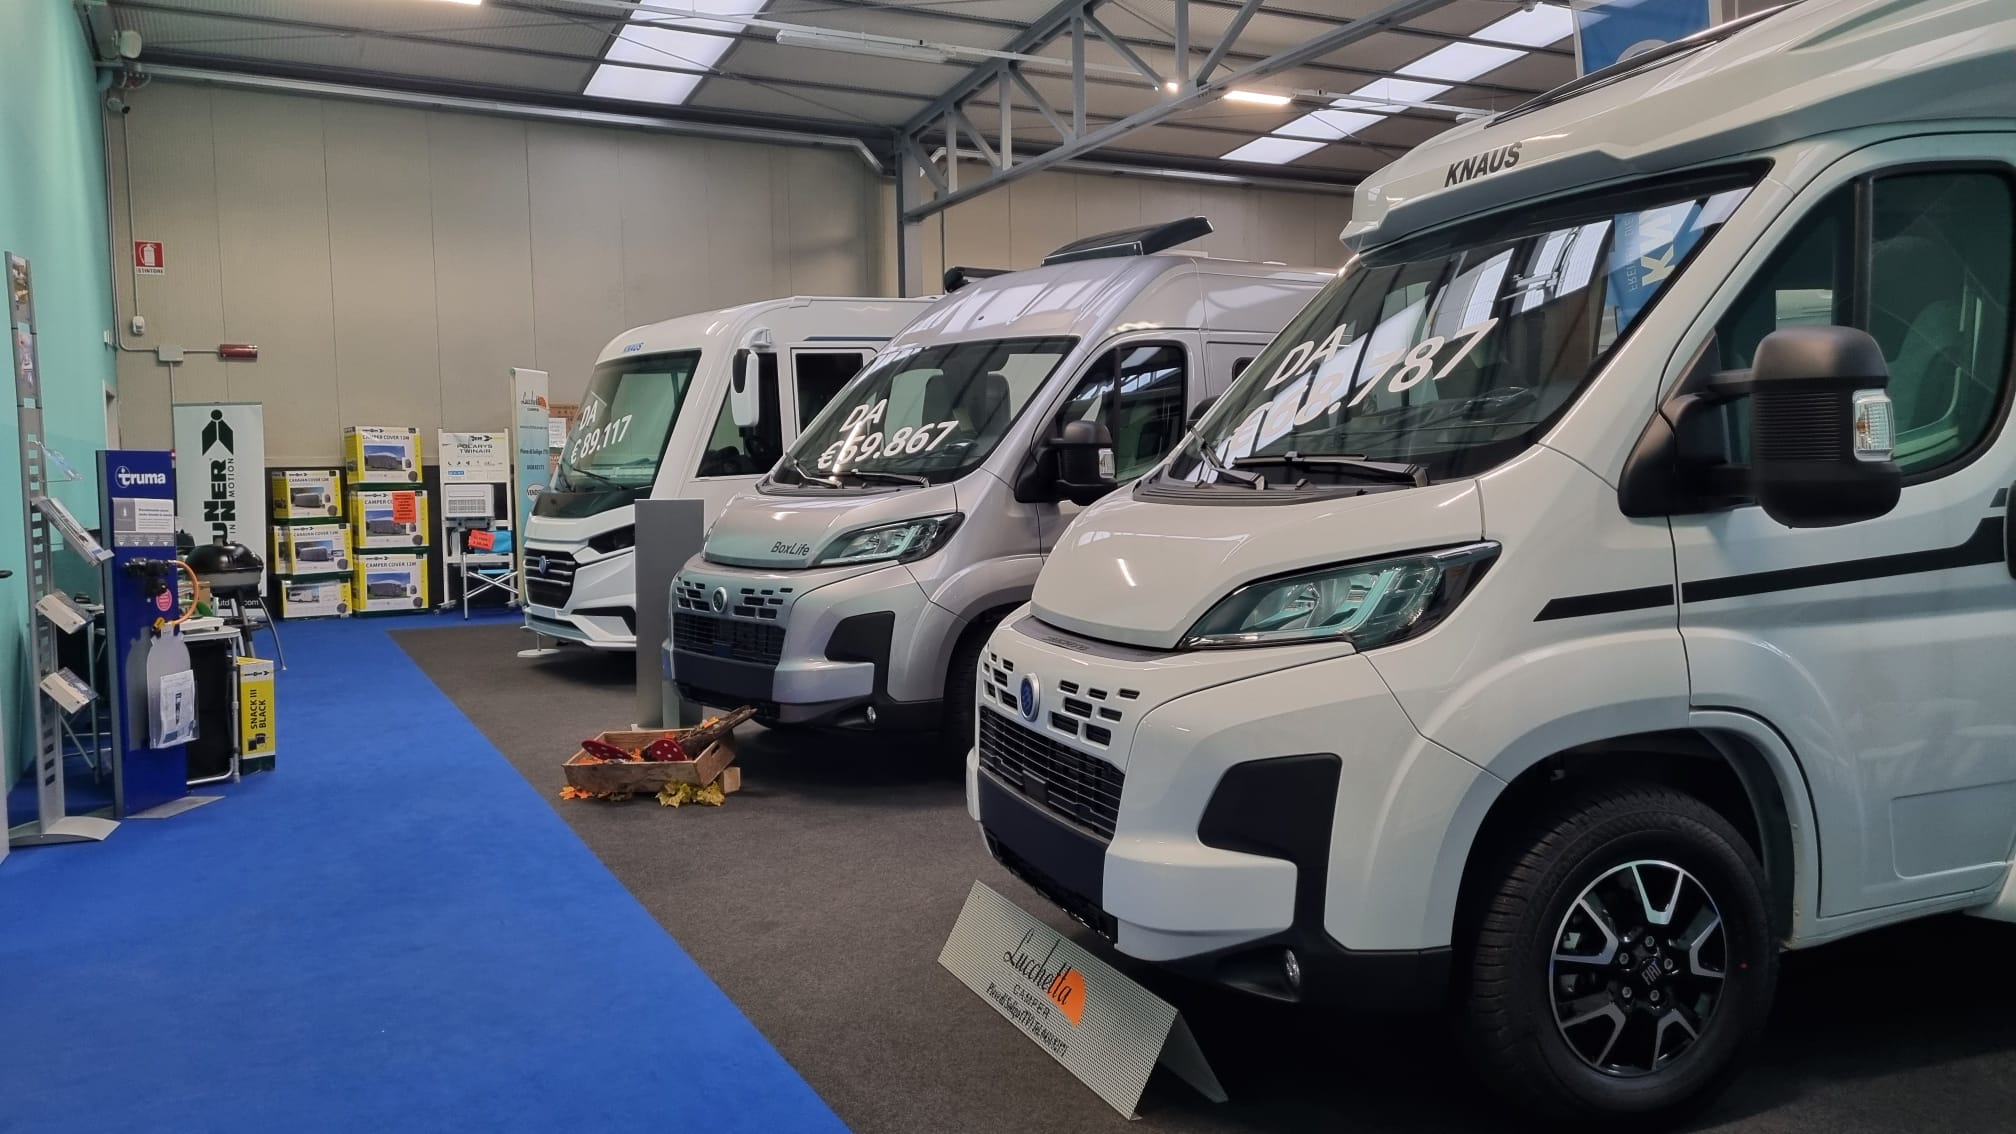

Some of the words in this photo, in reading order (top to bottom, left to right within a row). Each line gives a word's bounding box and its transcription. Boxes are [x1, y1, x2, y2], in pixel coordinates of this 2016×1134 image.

[1444, 141, 1523, 188] KNAUS
[1264, 323, 1347, 390] DA
[1229, 317, 1499, 451] €68.787
[579, 400, 599, 432] DA
[839, 399, 888, 432] DA
[117, 467, 166, 486] truma
[228, 458, 236, 498] MOTION
[229, 524, 236, 534] IN
[771, 541, 810, 556] BoxLife
[250, 699, 258, 729] SNACK
[258, 699, 266, 729] BLACK
[1003, 928, 1073, 1006] Lucchetta
[1641, 960, 1662, 986] FIAT
[1013, 984, 1051, 1020] CAMPER
